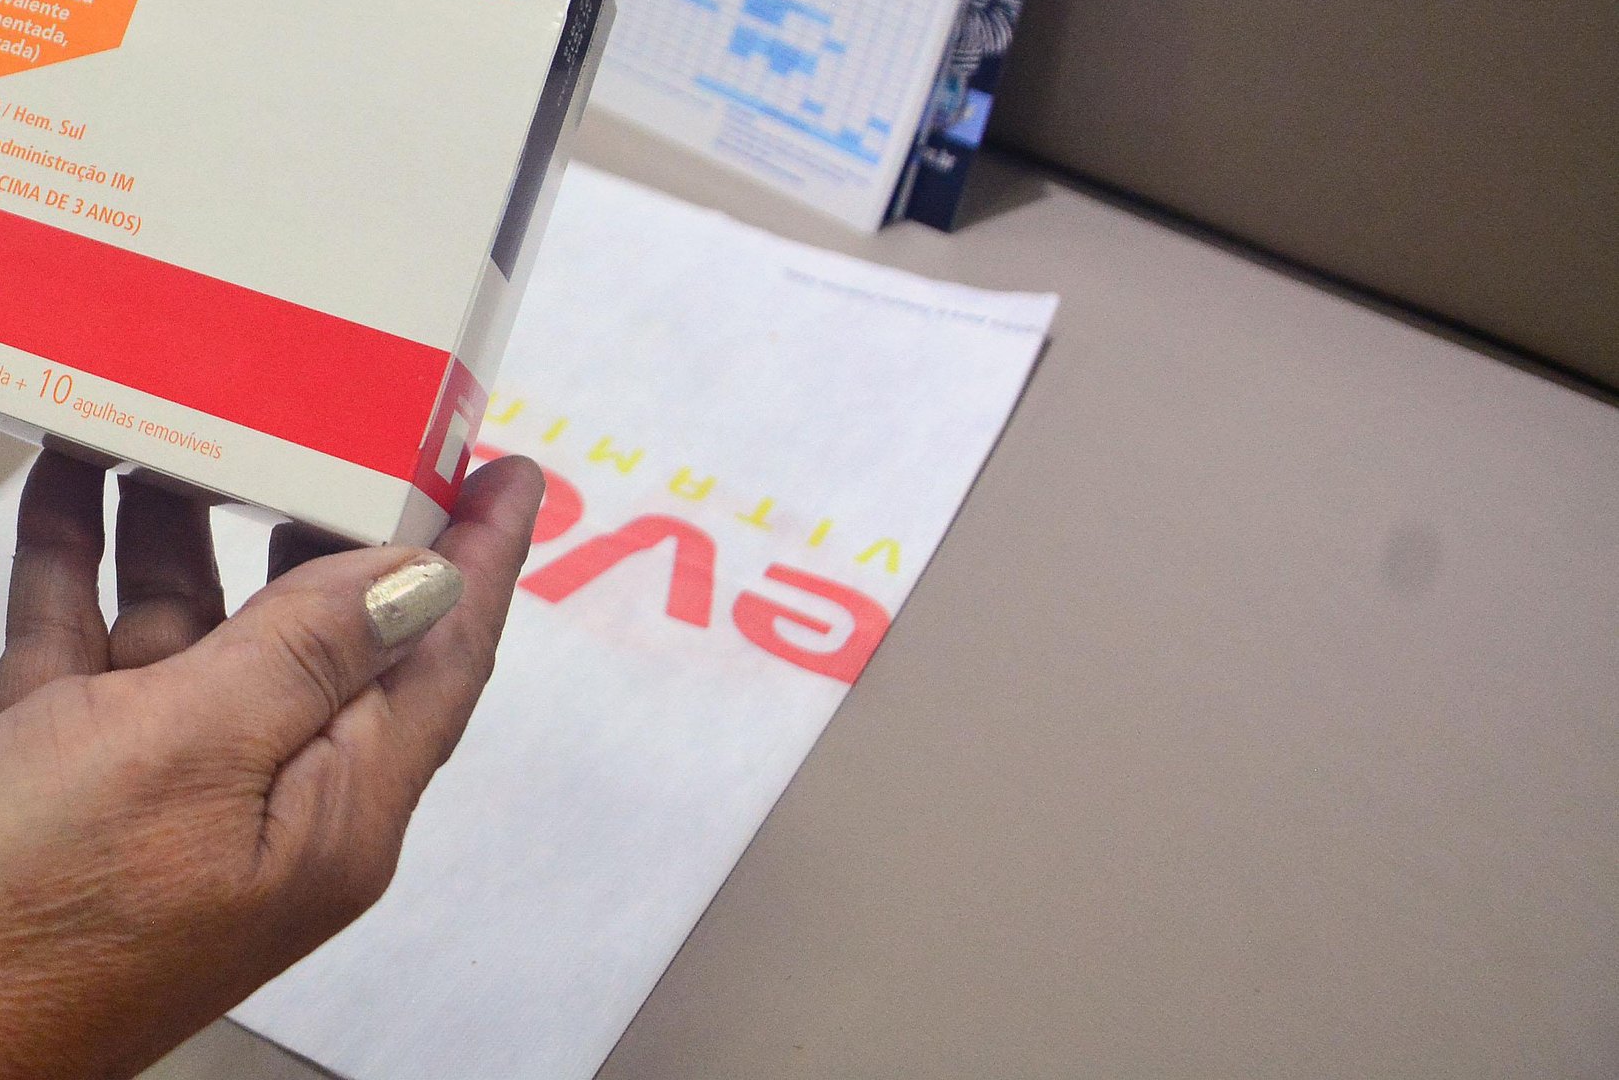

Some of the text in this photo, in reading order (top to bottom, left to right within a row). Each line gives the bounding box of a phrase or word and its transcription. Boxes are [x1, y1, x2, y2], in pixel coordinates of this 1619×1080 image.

[13, 105, 53, 131] Hem.
[58, 119, 87, 140] Sul
[111, 171, 135, 192] IM
[45, 188, 69, 209] DE
[71, 197, 84, 214] 3
[86, 202, 142, 236] ANOS)
[38, 368, 74, 405] 10
[73, 395, 134, 429] agulhas
[137, 417, 223, 460] removíveis
